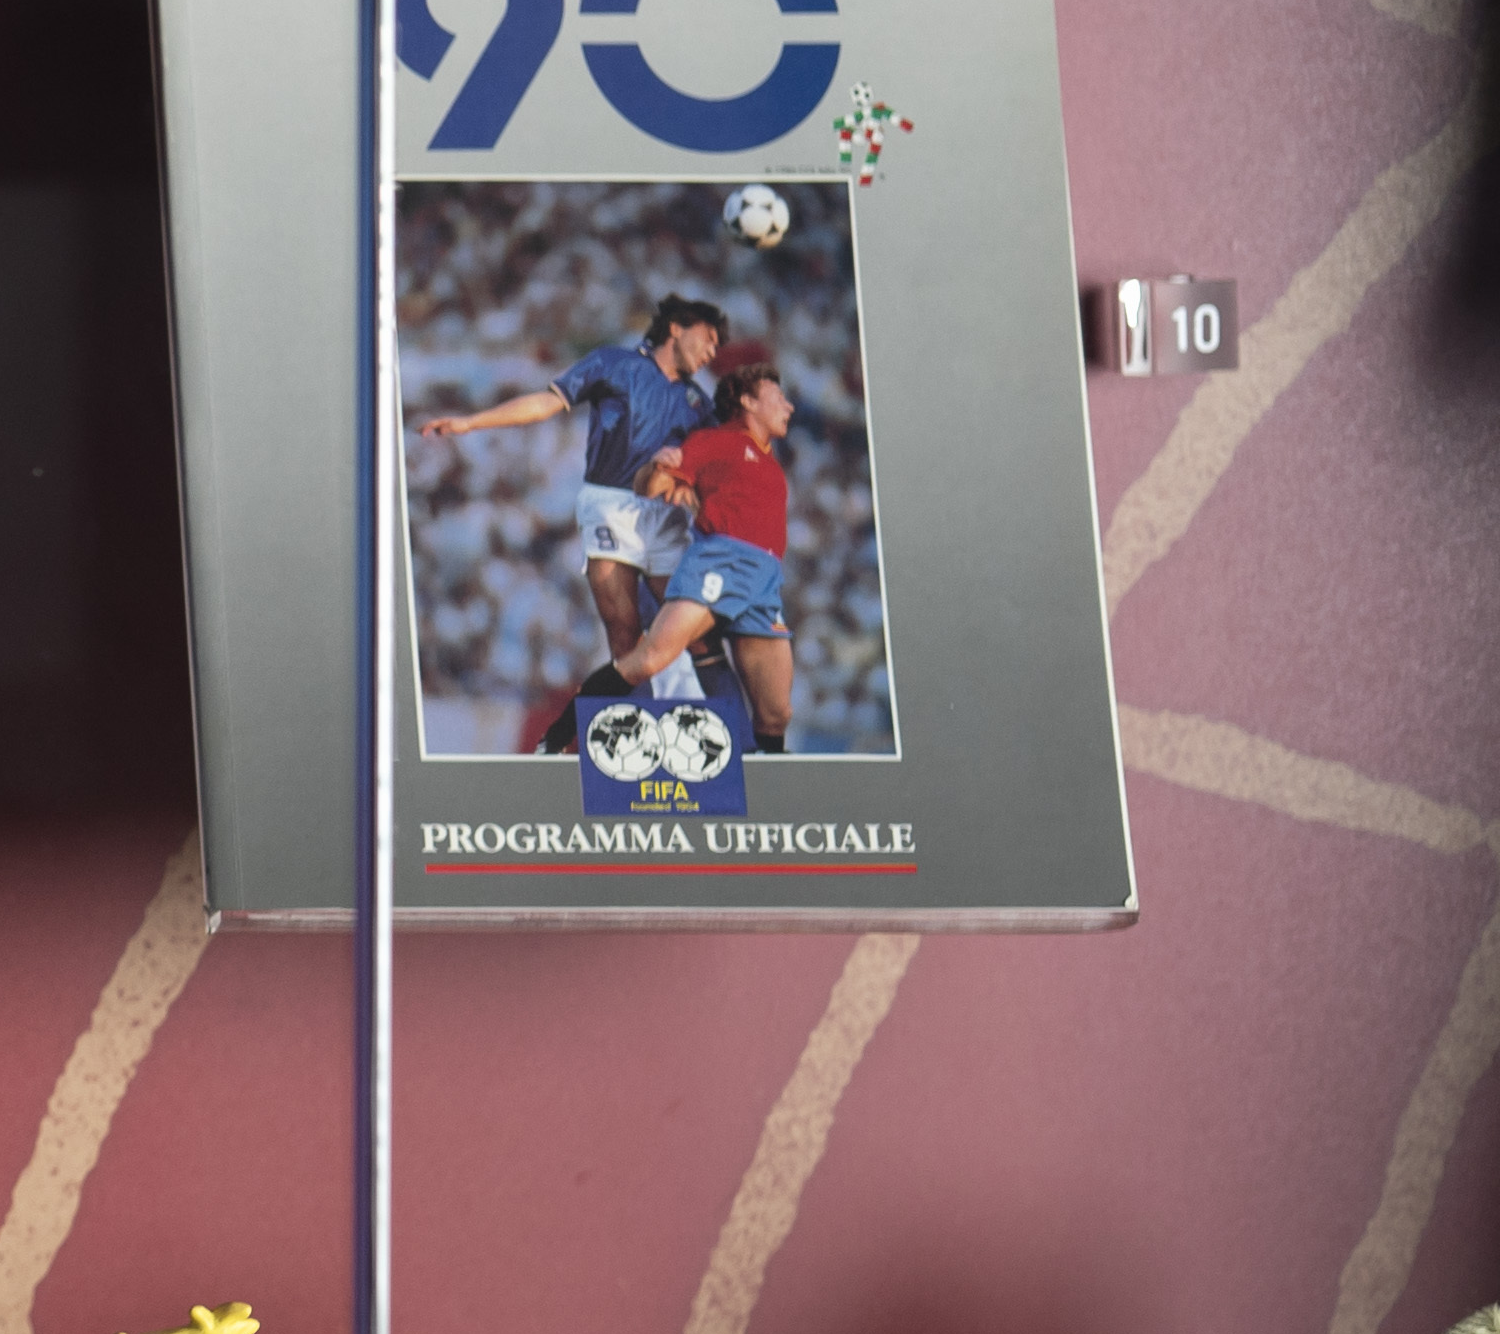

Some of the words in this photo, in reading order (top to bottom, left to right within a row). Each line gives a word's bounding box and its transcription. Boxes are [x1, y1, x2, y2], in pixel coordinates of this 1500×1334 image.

[1172, 303, 1221, 354] 10
[640, 780, 689, 801] FIFA
[420, 821, 694, 855] PROGRAMMA
[705, 821, 915, 855] UFFICIALE
